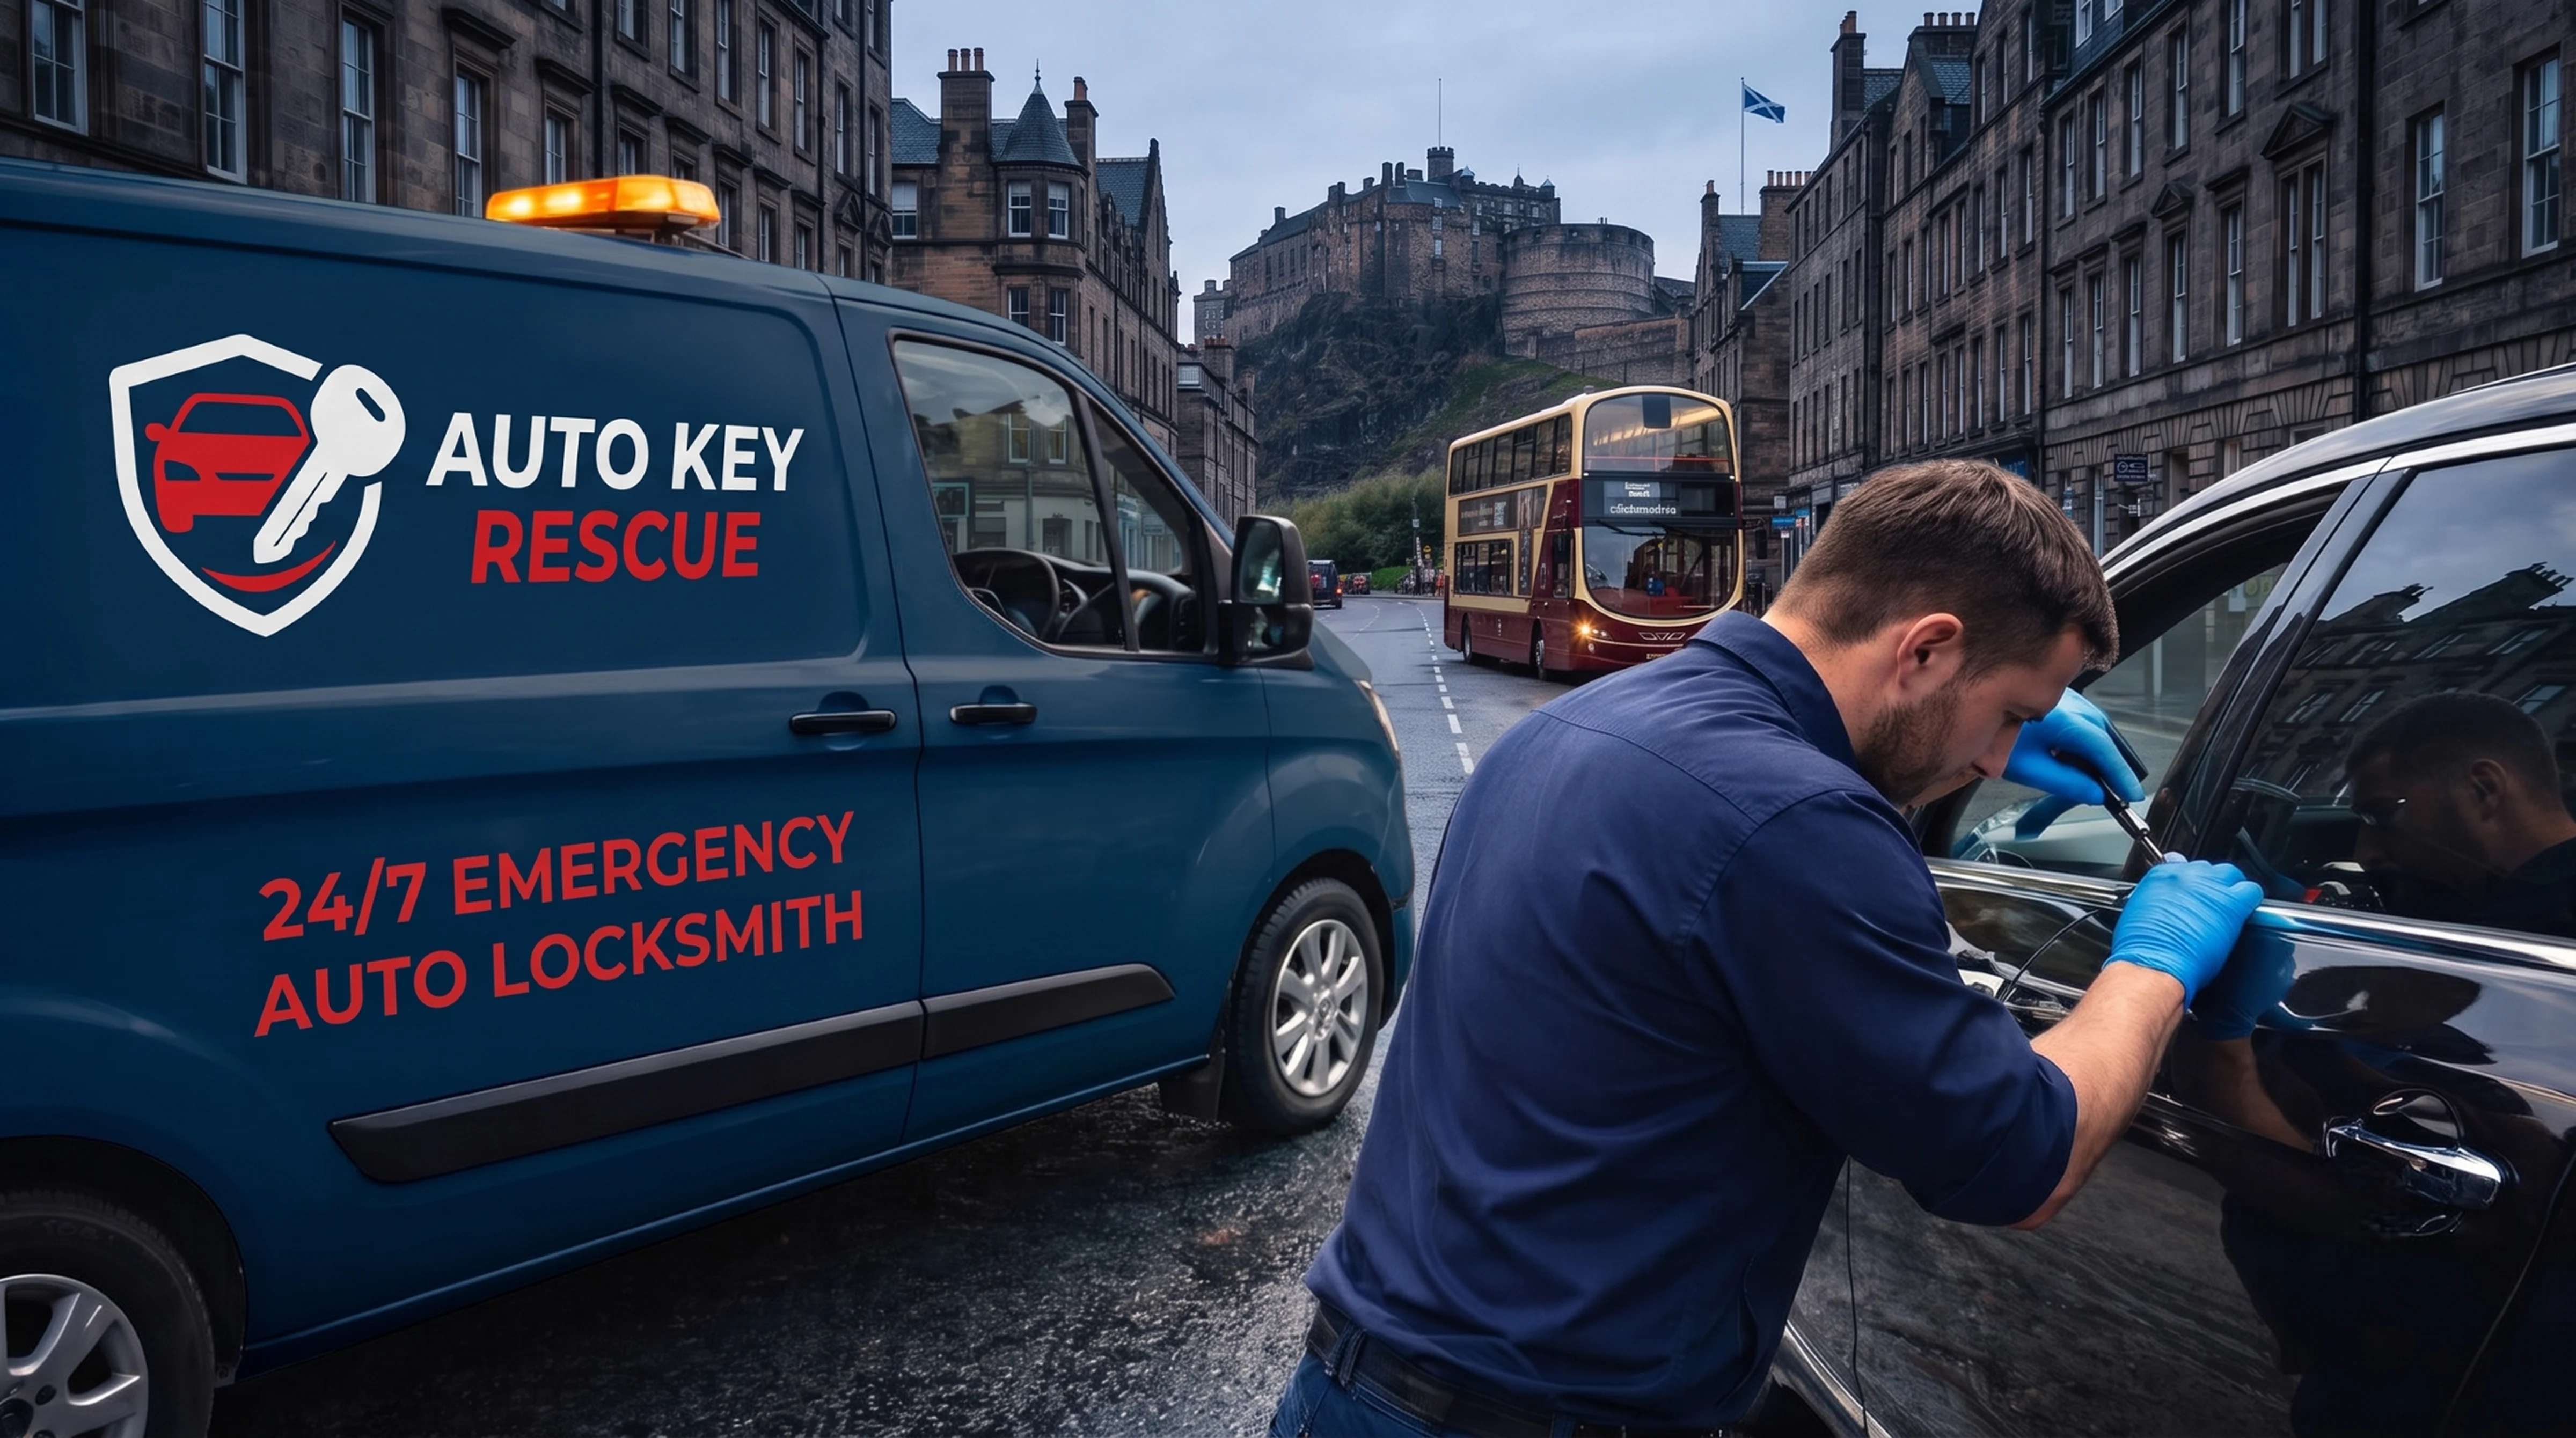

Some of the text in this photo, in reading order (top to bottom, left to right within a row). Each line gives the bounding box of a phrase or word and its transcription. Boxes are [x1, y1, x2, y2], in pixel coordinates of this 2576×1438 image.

[426, 412, 804, 491] AUTO KEY
[471, 510, 760, 583] RESCUE
[258, 811, 853, 940] 24/7 EMERGENCY
[254, 891, 862, 1037] AUTO LOCKSMITH
